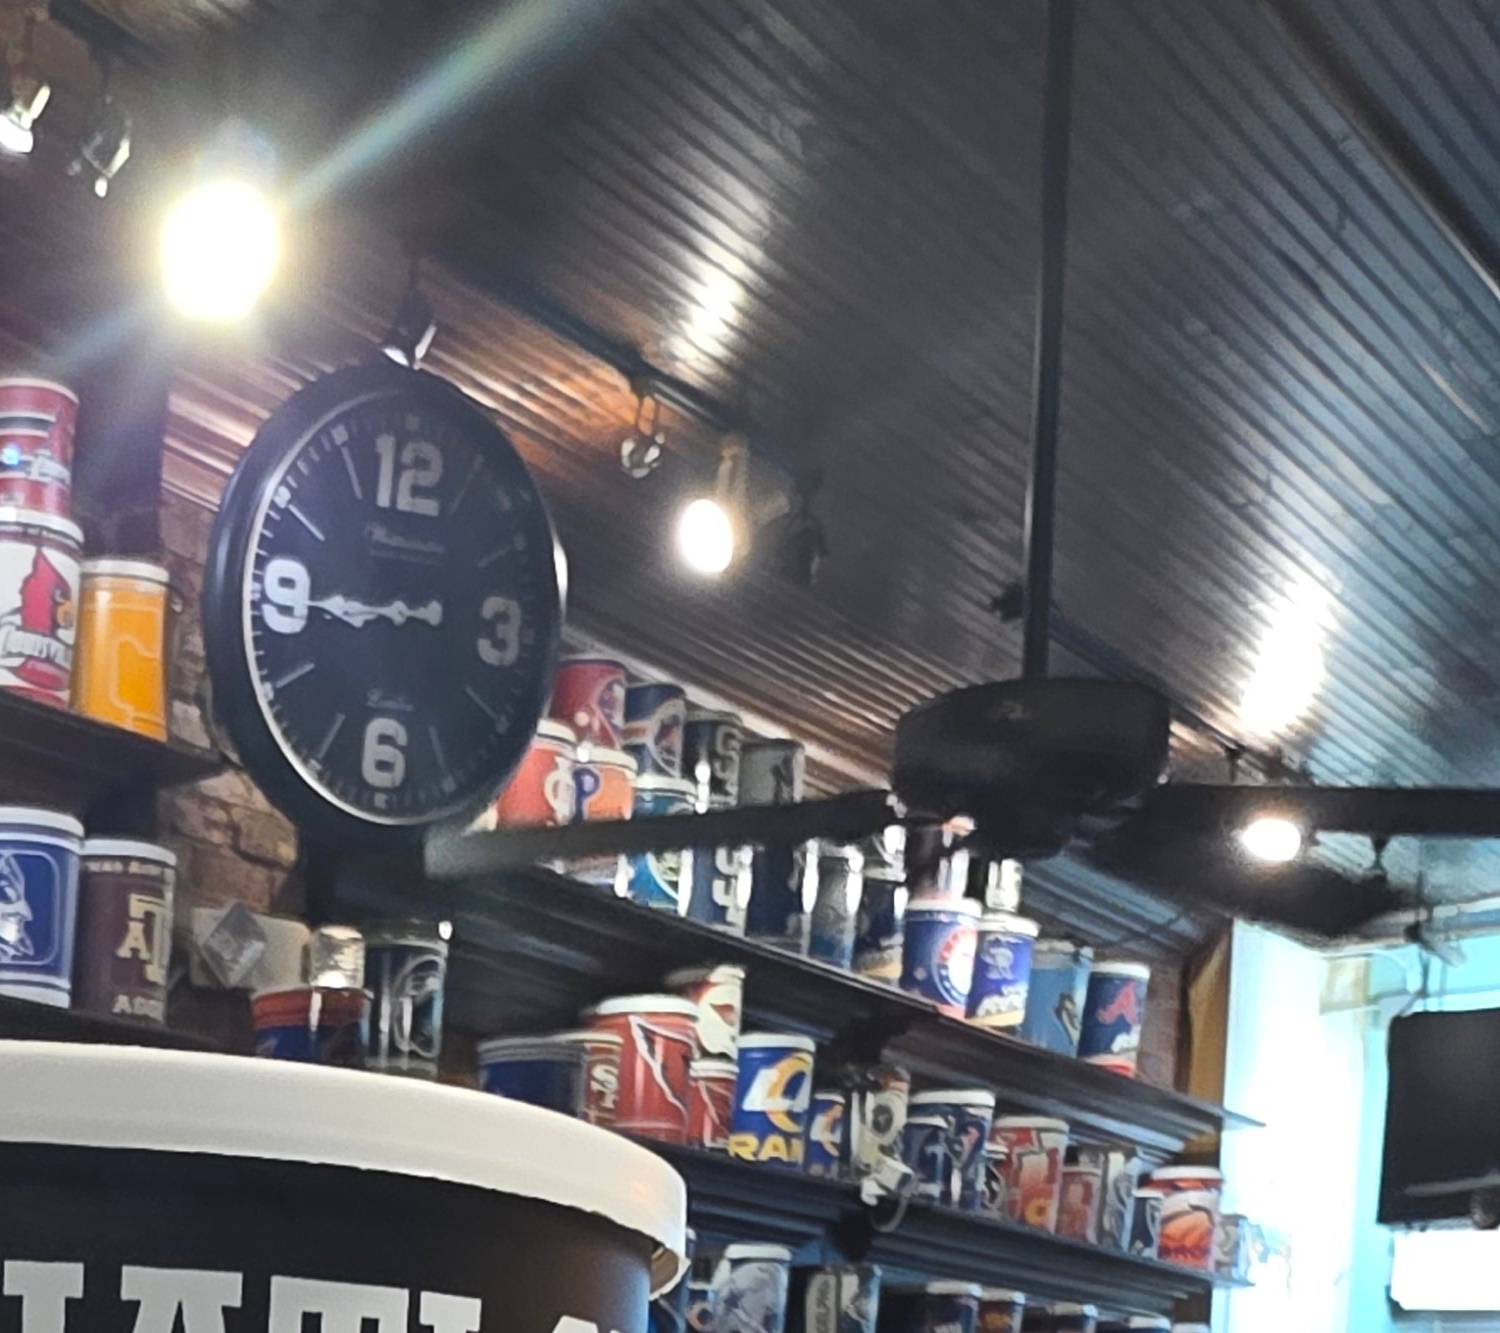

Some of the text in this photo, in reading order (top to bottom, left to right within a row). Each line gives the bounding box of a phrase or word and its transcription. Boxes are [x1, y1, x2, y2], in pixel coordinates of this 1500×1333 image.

[375, 433, 444, 517] 12
[263, 558, 311, 635] 9
[476, 595, 521, 667] 3
[361, 717, 408, 788] 6
